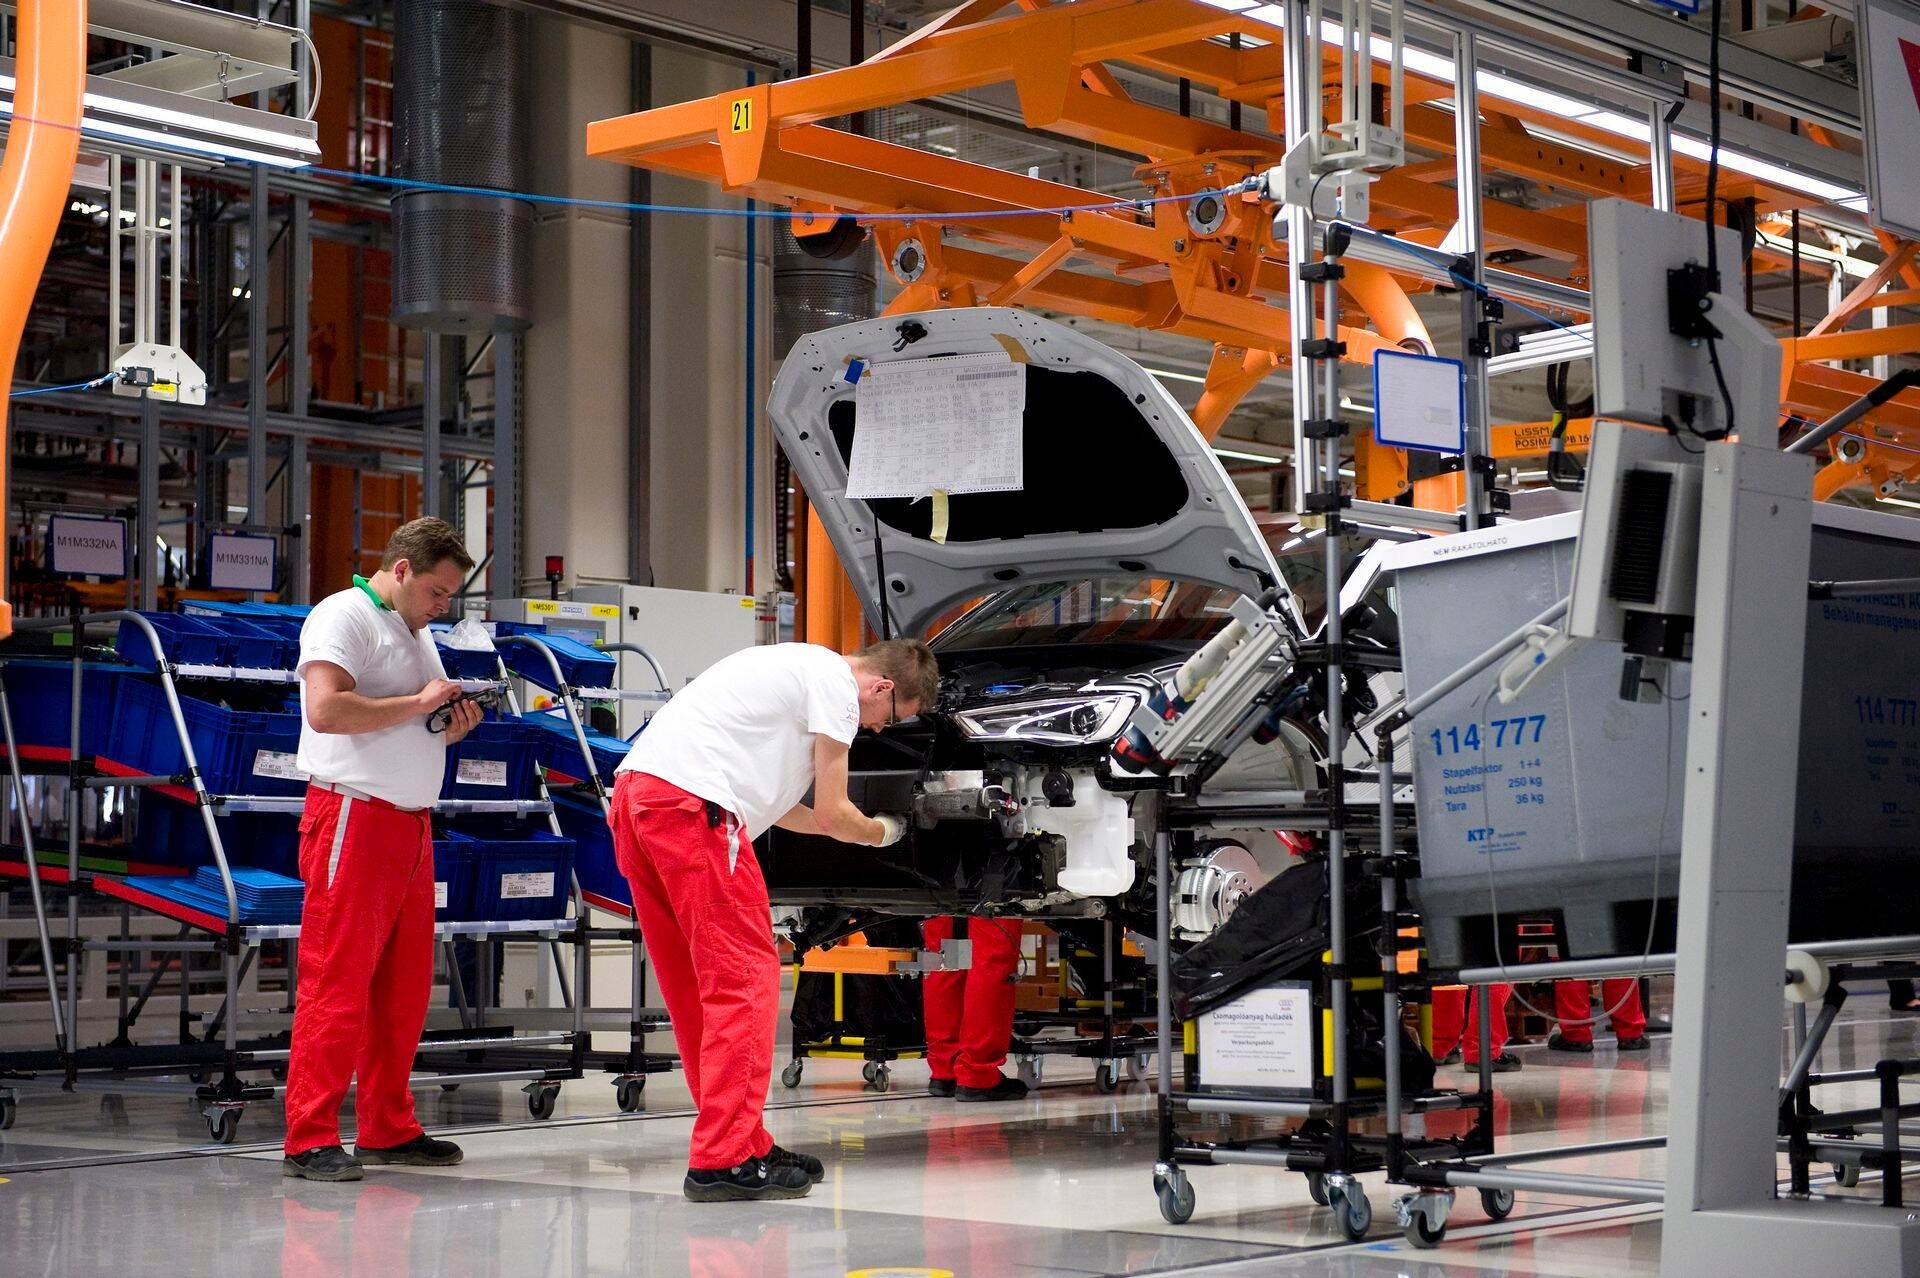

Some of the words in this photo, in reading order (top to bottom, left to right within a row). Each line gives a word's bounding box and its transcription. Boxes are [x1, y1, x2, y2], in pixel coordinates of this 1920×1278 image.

[734, 102, 749, 131] 21
[57, 535, 118, 550] M1M332NA
[216, 552, 269, 567] M1M331NA
[1855, 695, 1884, 724] 114
[1888, 698, 1917, 726] 777
[1431, 724, 1480, 755] 114
[1491, 714, 1546, 748] 777
[1443, 764, 1503, 779] Stapelfaktor
[1508, 777, 1527, 788] 250
[1530, 776, 1543, 788] kg
[1446, 801, 1467, 812] Tara
[1516, 793, 1529, 805] 36
[1531, 792, 1545, 805] kg
[1467, 828, 1494, 842] KTP
